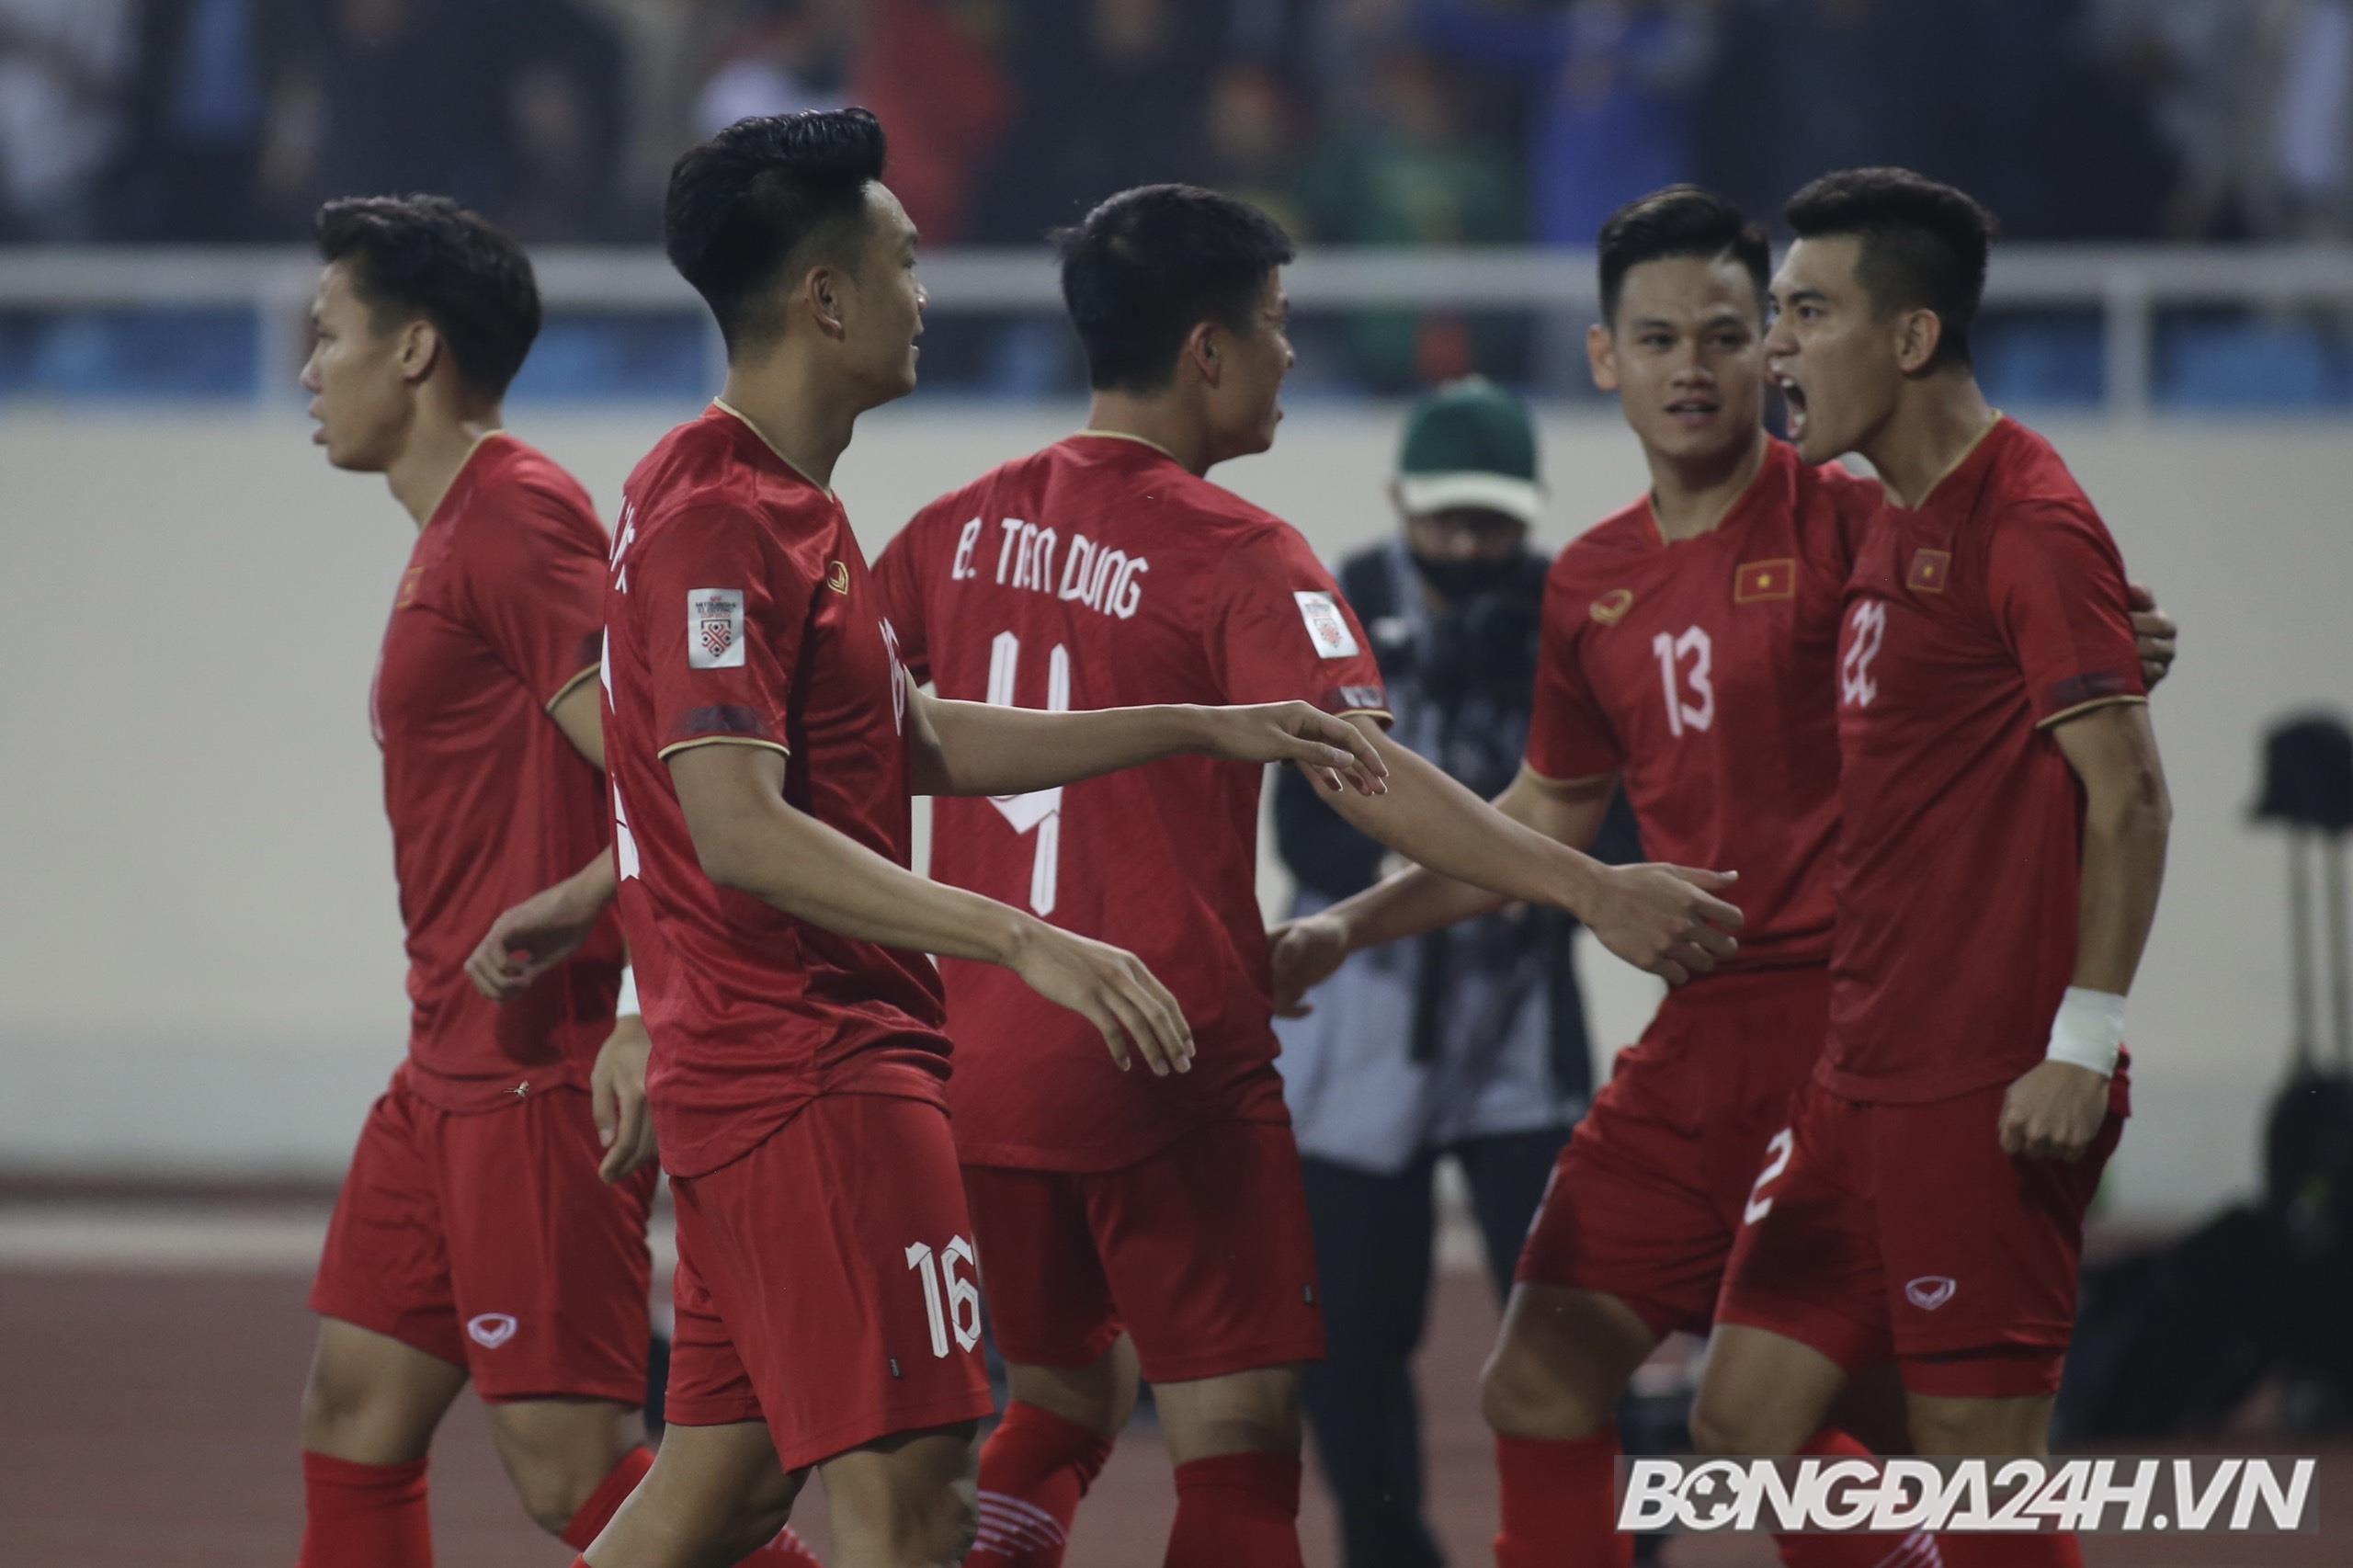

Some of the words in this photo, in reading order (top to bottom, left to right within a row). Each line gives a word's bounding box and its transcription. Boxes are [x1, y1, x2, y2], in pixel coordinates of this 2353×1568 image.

[952, 516, 982, 580] B.
[1059, 533, 1148, 619] DUNG
[1654, 625, 1713, 736] 13
[1843, 600, 1886, 707] 22
[986, 630, 1070, 917] 4
[904, 1234, 982, 1358] 16
